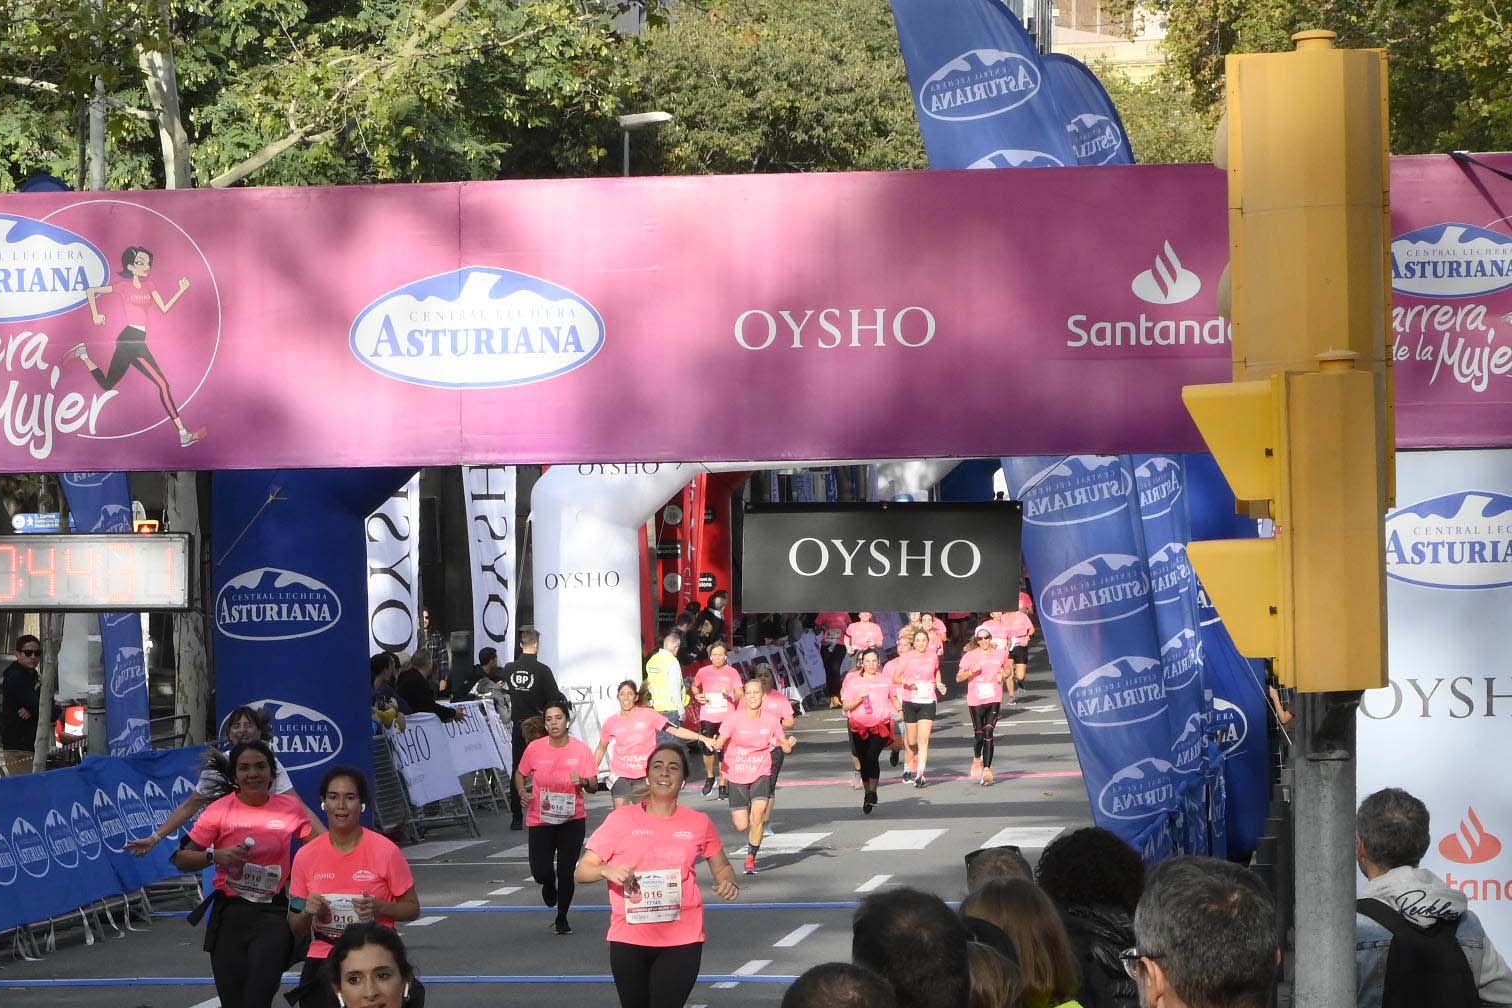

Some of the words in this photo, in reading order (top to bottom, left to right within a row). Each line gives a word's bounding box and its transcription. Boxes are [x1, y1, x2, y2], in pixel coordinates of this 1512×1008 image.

[11, 248, 85, 262] LECHERA
[734, 306, 936, 350] OYSHO
[1392, 303, 1488, 333] arrera
[369, 314, 584, 359] ASTURIANA
[1067, 314, 1233, 348] Santand
[1416, 334, 1434, 361] la
[1414, 525, 1482, 536] CENTRAL
[788, 537, 982, 579] OYSHO
[544, 569, 621, 591] OYSHO
[279, 592, 328, 600] LECHERA
[219, 597, 332, 626] ASTURIANA
[515, 675, 529, 684] BP
[269, 734, 333, 754] RIANA
[644, 890, 663, 899] 016
[333, 914, 354, 923] 016
